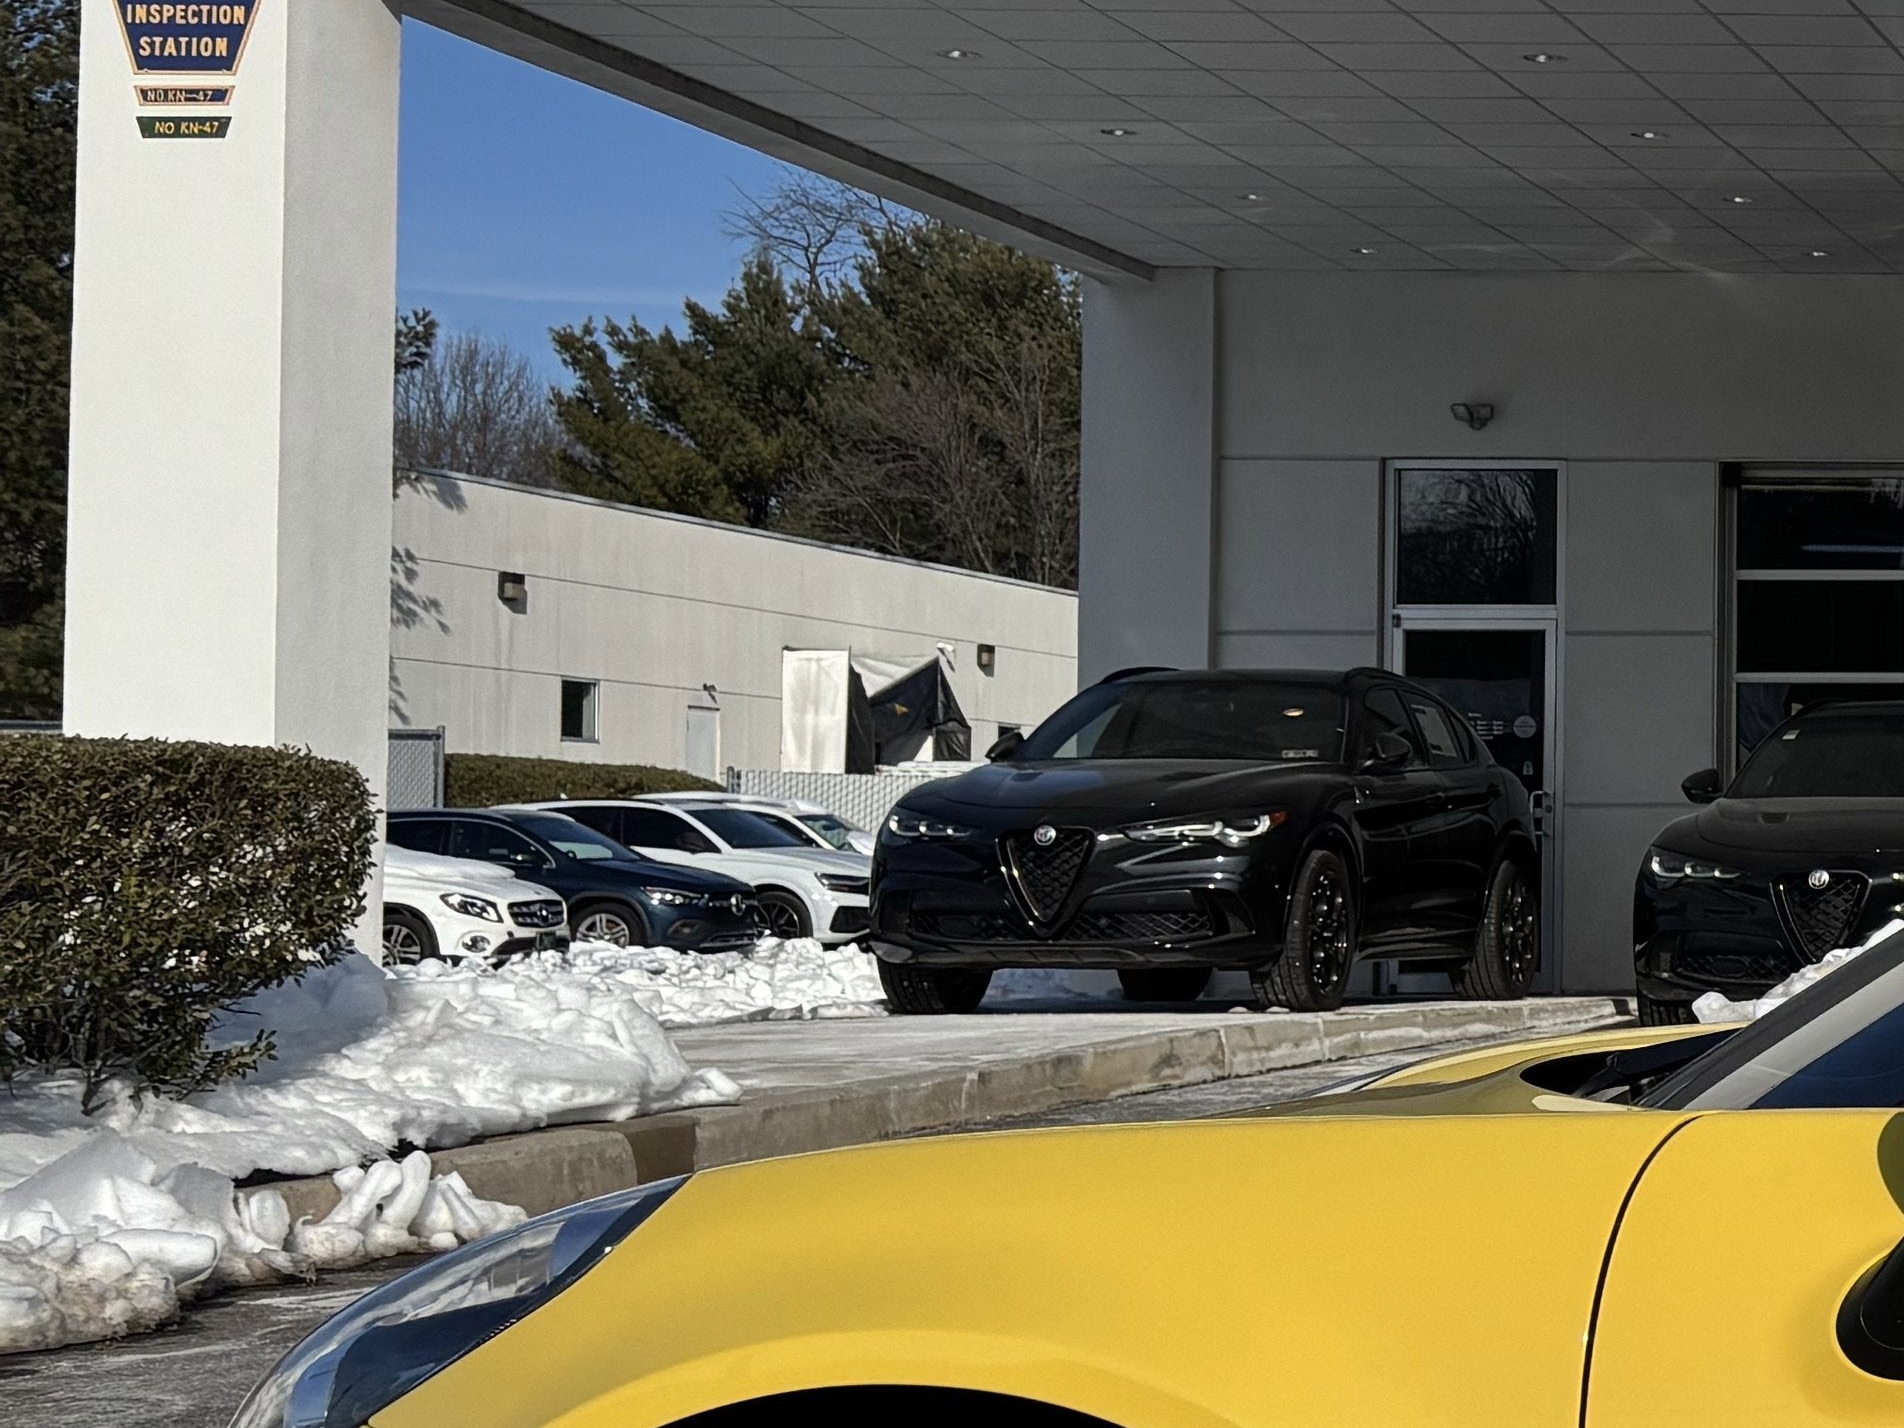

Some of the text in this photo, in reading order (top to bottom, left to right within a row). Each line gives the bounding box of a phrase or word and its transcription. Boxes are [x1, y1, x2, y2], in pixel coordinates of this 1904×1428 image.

[126, 3, 246, 25] INSPECTION
[138, 35, 229, 57] STATION
[154, 121, 175, 134] NO
